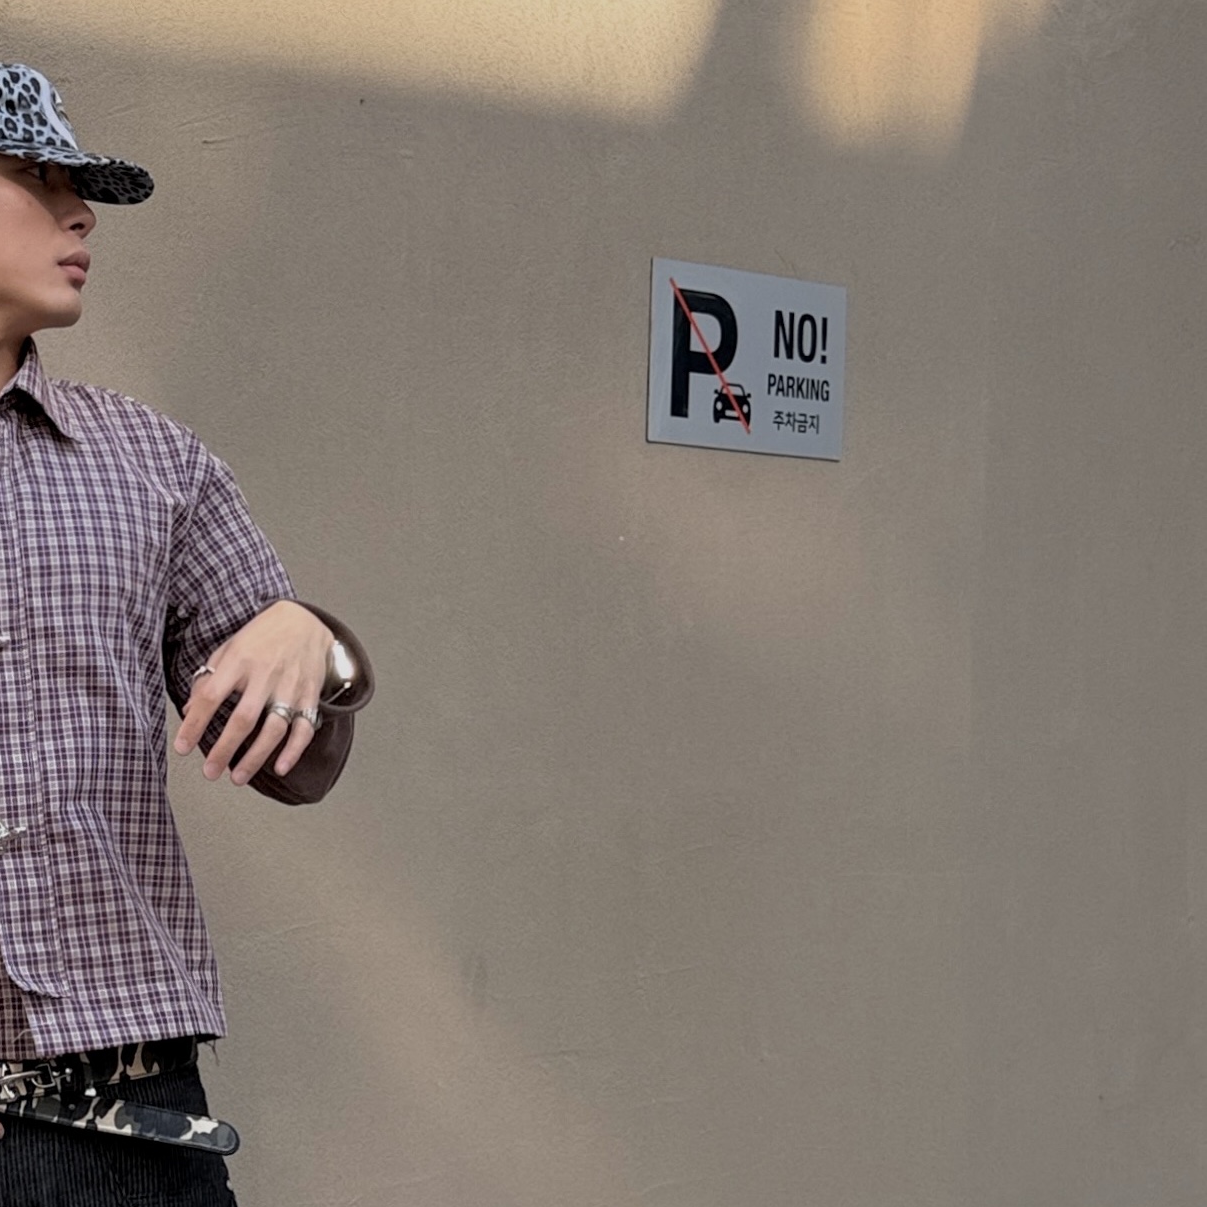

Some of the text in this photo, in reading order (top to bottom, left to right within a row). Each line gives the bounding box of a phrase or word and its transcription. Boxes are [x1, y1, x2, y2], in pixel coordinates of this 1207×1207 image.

[773, 310, 828, 364] NO!
[767, 373, 830, 402] PARKING
[772, 411, 820, 435] 주차금지
